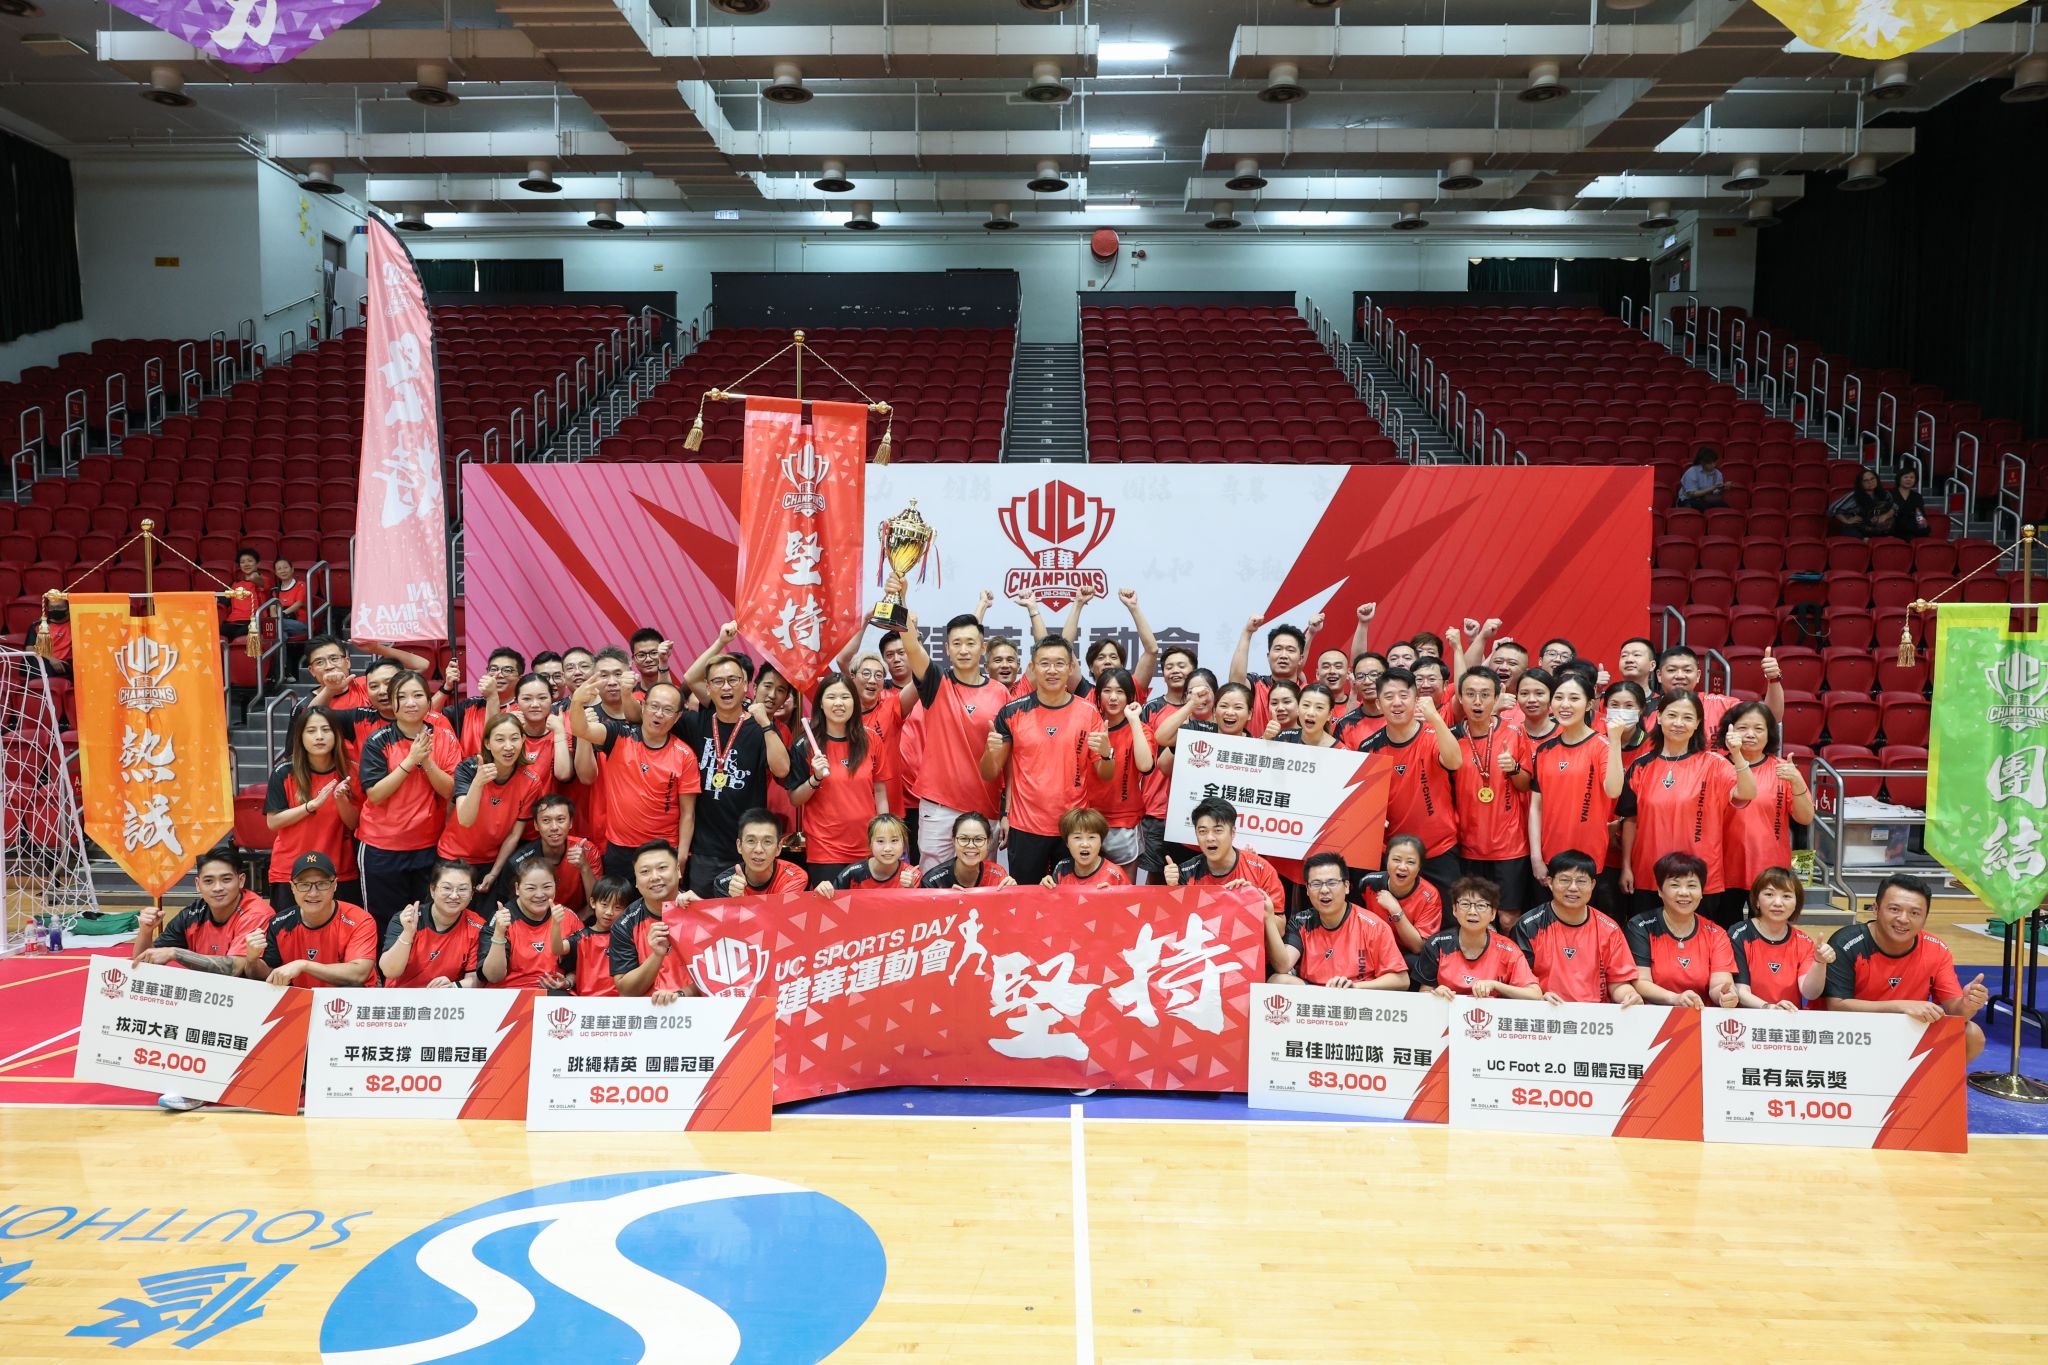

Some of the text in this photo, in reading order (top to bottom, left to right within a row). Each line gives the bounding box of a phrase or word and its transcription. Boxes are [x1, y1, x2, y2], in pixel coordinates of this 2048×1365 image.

[1028, 479, 1085, 545] UC
[1038, 549, 1075, 569] 建華
[1008, 571, 1105, 594] CHAMPIONS
[127, 636, 160, 675] UC
[2004, 652, 2040, 692] UC
[119, 688, 176, 703] CHAMPIONS
[1195, 740, 1208, 754] UC
[1216, 749, 1317, 774] 建華運動會 2025
[1225, 765, 1249, 773] SPORTS
[118, 724, 184, 856] 熱誠
[1203, 783, 1291, 808] 全場總冠軍
[1981, 744, 2048, 881] 團結
[774, 913, 958, 982] UC SPORTS DAY
[706, 937, 750, 985] UC
[107, 968, 121, 983] UC
[776, 938, 956, 1020] 建華運動會
[131, 979, 234, 1008] 建華運動會 2025
[988, 912, 1243, 1061] 堅持
[139, 996, 164, 1006] SPORTS
[331, 998, 345, 1013] UC
[1270, 994, 1285, 1009] UC
[356, 1006, 465, 1021] 建華運動會 2025
[554, 1007, 569, 1022] UC
[580, 1015, 692, 1030] 建華運動會 2025
[1296, 1003, 1408, 1023] 建華運動會 2025
[1471, 1008, 1486, 1023] UC
[116, 1016, 249, 1051] 拔河大賽 團體冠軍
[1498, 1017, 1614, 1036] 建華運動會 2025
[1723, 1018, 1739, 1034] UC
[1751, 1027, 1871, 1046] 建華運動會 2025
[134, 1047, 206, 1074] $2,000
[344, 1046, 488, 1063] 平板支撐 團體冠軍
[1285, 1040, 1432, 1067] 最佳啦啦隊 冠軍
[567, 1056, 715, 1073] 跳繩精英 團體冠軍
[1487, 1059, 1644, 1080] UC Foot 2.0 團體冠軍
[366, 1074, 442, 1093] $2,000
[1308, 1070, 1387, 1092] $3,000
[1742, 1067, 1847, 1089] 最有氣氛獎
[589, 1085, 669, 1105] $2,000
[1511, 1087, 1593, 1108] $2,000
[1767, 1099, 1852, 1120] $1,000
[0, 1256, 300, 1350] 修
